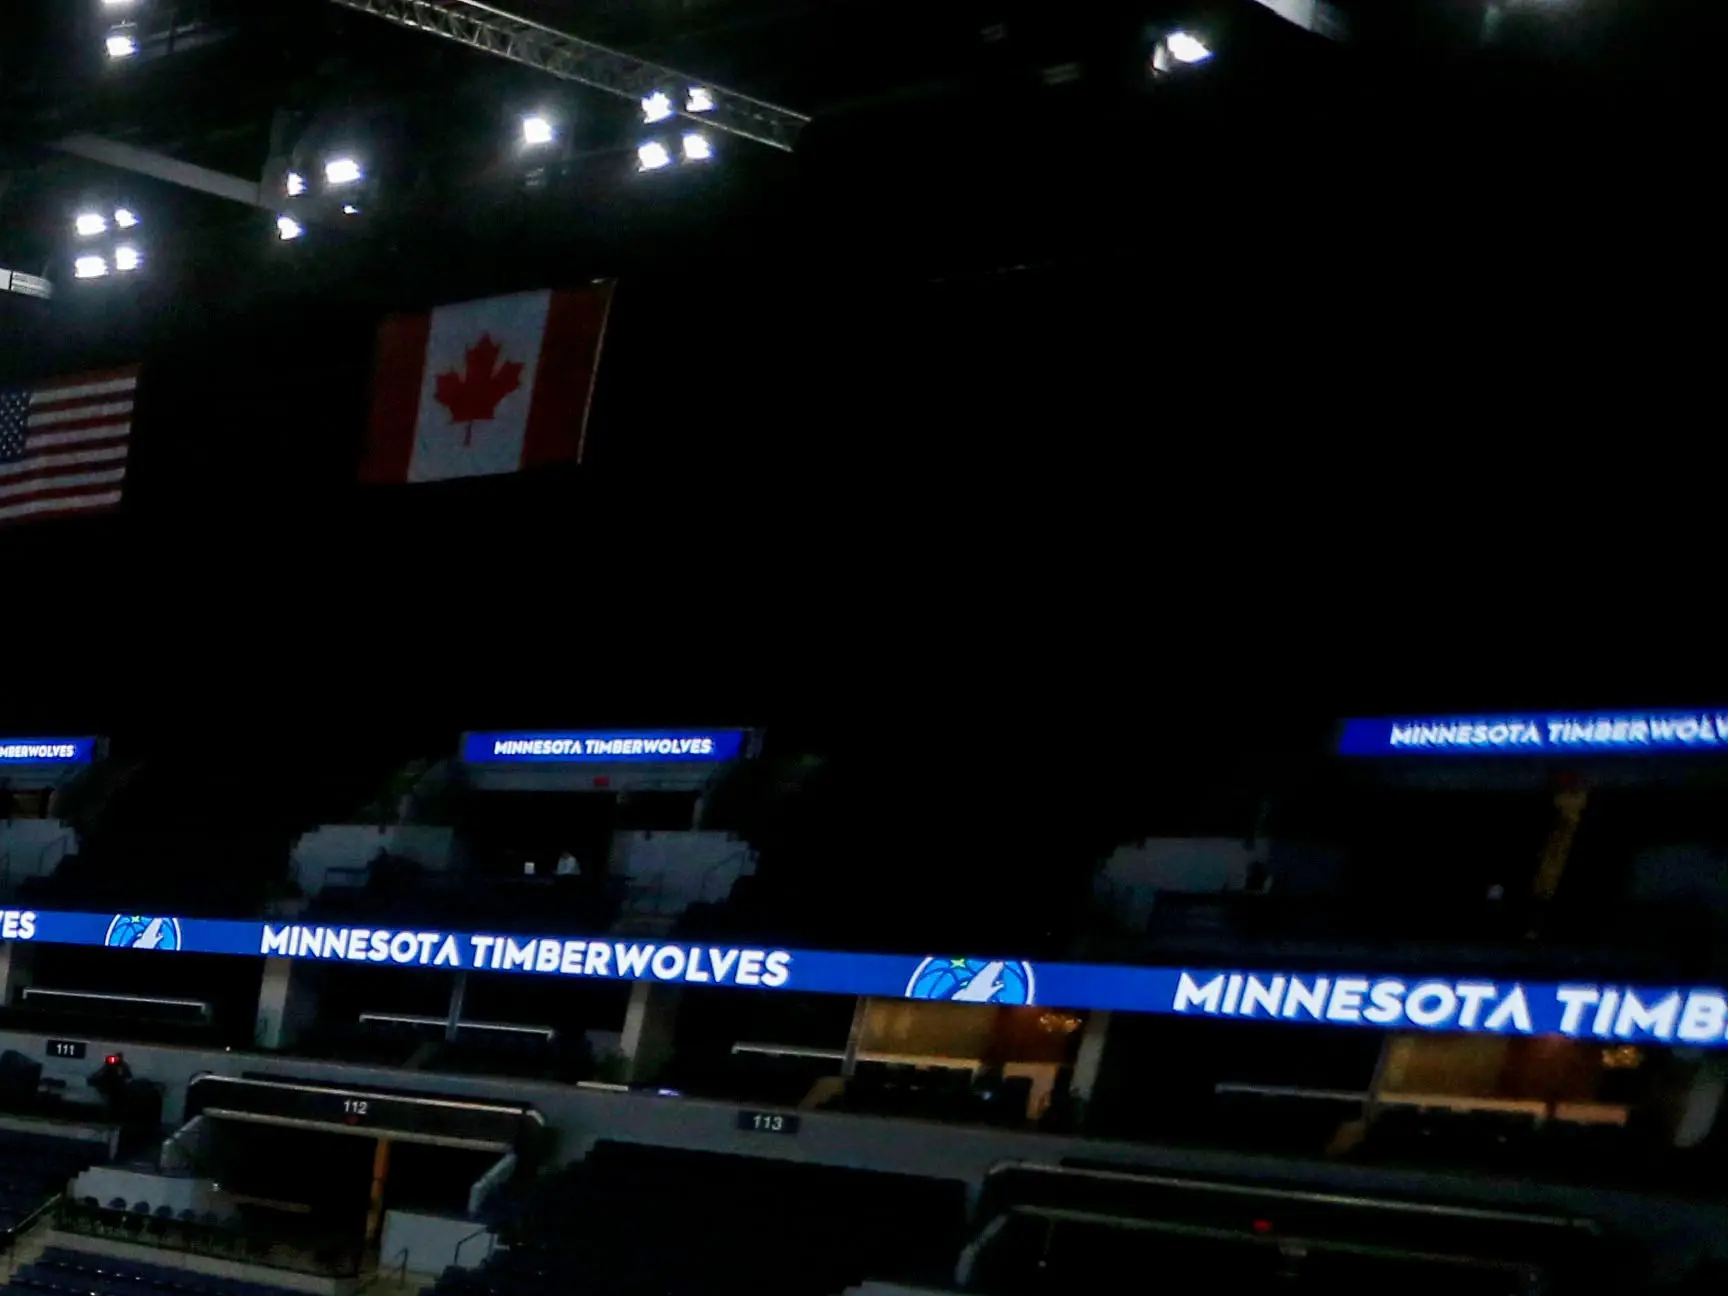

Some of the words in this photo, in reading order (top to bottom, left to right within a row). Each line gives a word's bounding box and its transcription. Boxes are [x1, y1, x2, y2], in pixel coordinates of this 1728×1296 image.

[1389, 719, 1542, 749] MINNESOTA
[493, 739, 583, 756] MINNESOTA
[583, 738, 714, 755] TIMBERWOLVES
[258, 924, 461, 968] MINNESOTA
[469, 935, 791, 987] TIMBERWOLVES
[1172, 971, 1534, 1035] MINNESOTA
[56, 1043, 76, 1057] 111
[343, 1099, 369, 1116] 112
[752, 1113, 784, 1131] 113
